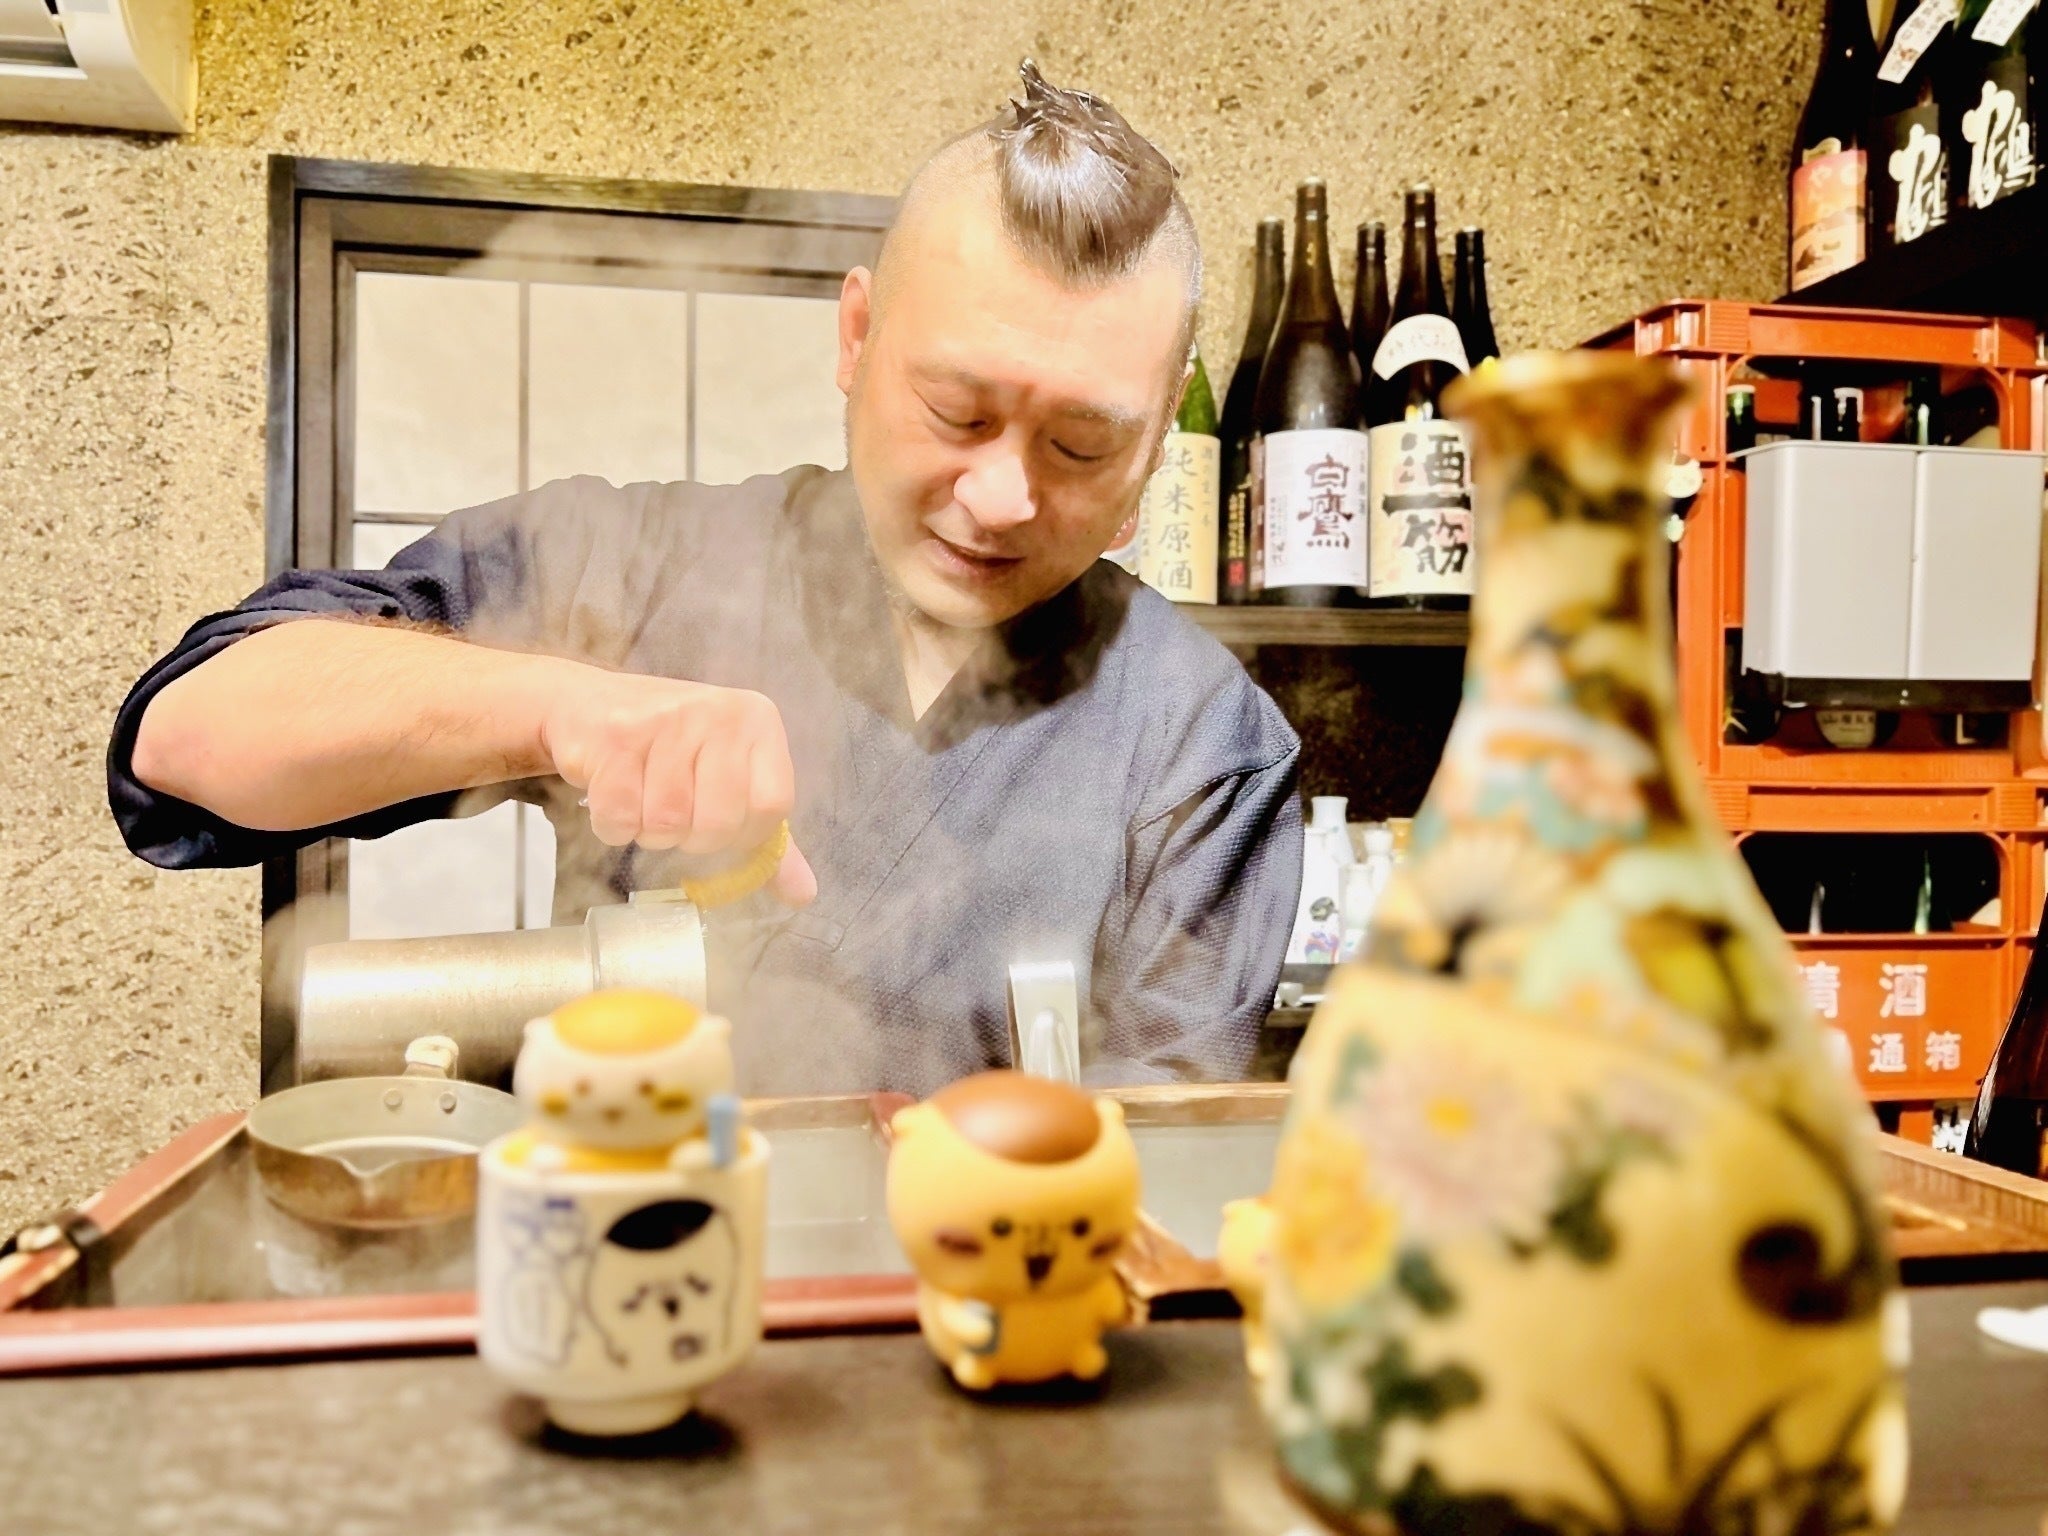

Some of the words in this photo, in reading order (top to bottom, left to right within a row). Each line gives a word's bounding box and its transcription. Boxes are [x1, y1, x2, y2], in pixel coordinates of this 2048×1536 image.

[1157, 446, 1198, 591] 純米原酒
[1297, 452, 1354, 550] 白鷹
[1382, 432, 1472, 575] 酒一筋
